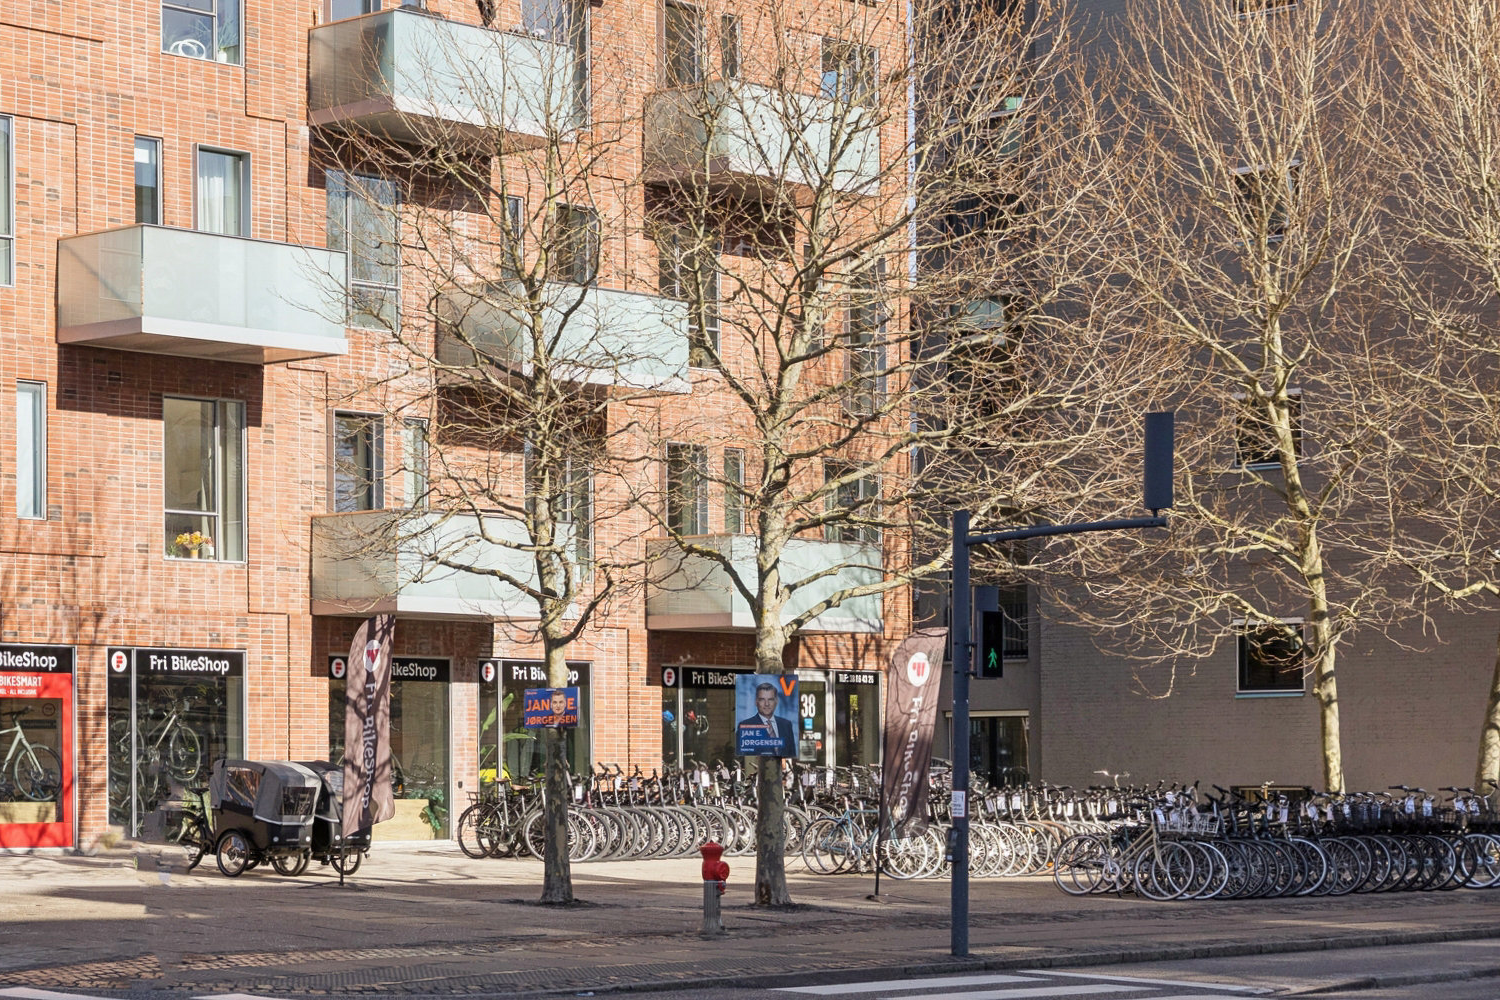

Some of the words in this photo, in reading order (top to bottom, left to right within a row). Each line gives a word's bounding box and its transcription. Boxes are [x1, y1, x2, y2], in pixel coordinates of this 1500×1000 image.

[150, 655, 168, 670] Fri
[171, 656, 230, 675] BikeShop
[392, 662, 437, 680] ikeShop
[512, 666, 527, 680] Fri
[530, 666, 578, 684] Bikop
[692, 671, 706, 684] Fri
[708, 672, 736, 685] BikeS
[526, 698, 550, 712] JAN
[801, 694, 816, 717] 38
[741, 730, 754, 738] JAN
[741, 739, 783, 747] JØRGENSEN
